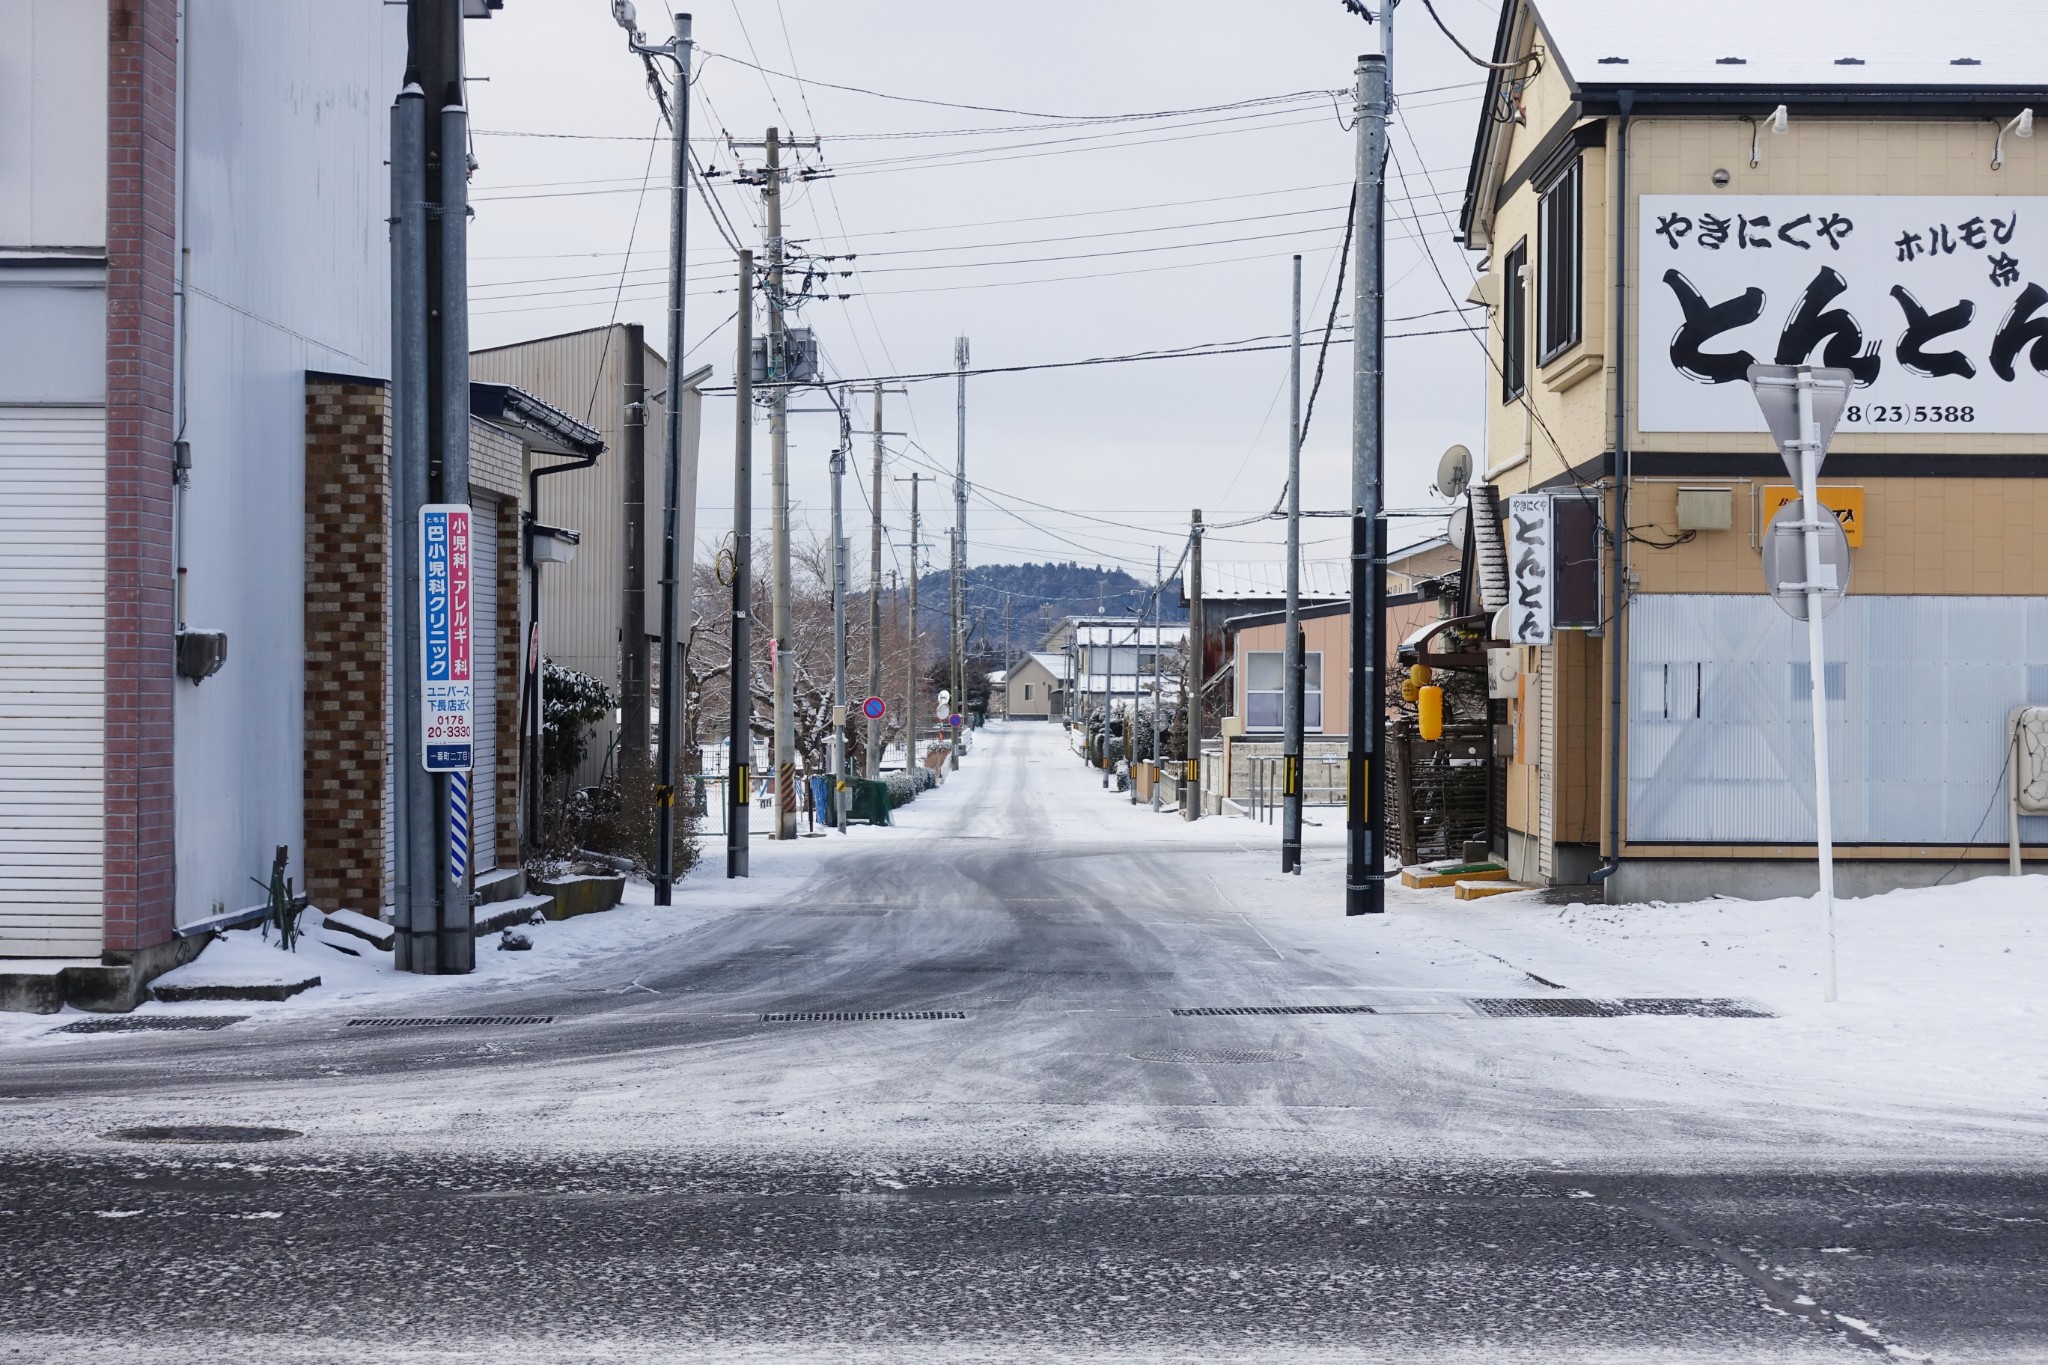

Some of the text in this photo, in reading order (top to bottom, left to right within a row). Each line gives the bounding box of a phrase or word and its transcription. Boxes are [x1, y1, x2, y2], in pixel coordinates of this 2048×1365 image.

[1655, 212, 1854, 251] やきにくや
[1894, 209, 2017, 262] ホルモン
[1838, 402, 1975, 425] 8(23)5388
[1513, 499, 1547, 512] やきにくや
[1512, 513, 1546, 642] とんとん
[427, 525, 447, 676] 巴小児科クリニック
[452, 517, 468, 676] 小児科・アレルギー科
[427, 686, 470, 697] ユニバース
[427, 699, 471, 712] 下長店近く
[437, 715, 464, 725] 0178
[427, 726, 471, 738] 20-3330
